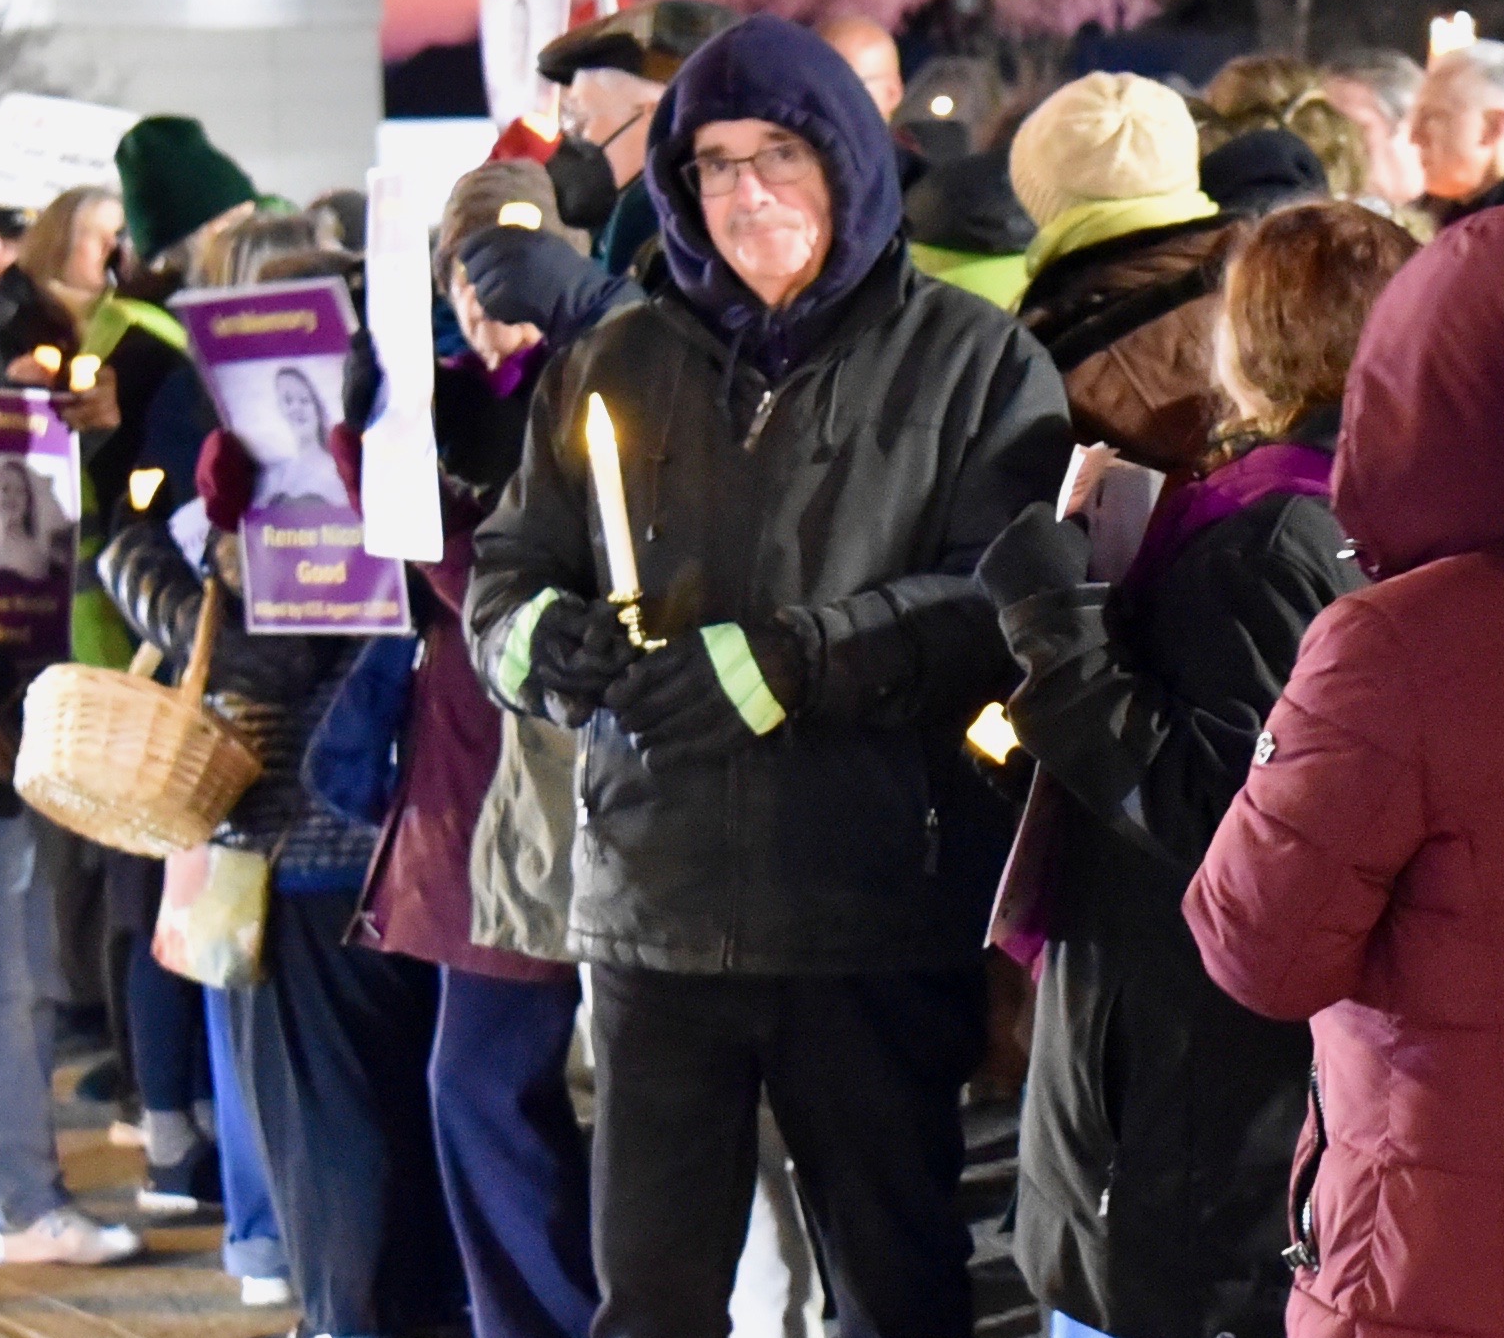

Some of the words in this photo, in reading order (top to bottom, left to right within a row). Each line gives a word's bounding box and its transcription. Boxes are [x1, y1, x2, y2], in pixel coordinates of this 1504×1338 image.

[262, 524, 319, 548] Renee
[321, 524, 363, 546] Nico
[296, 560, 347, 585] Good
